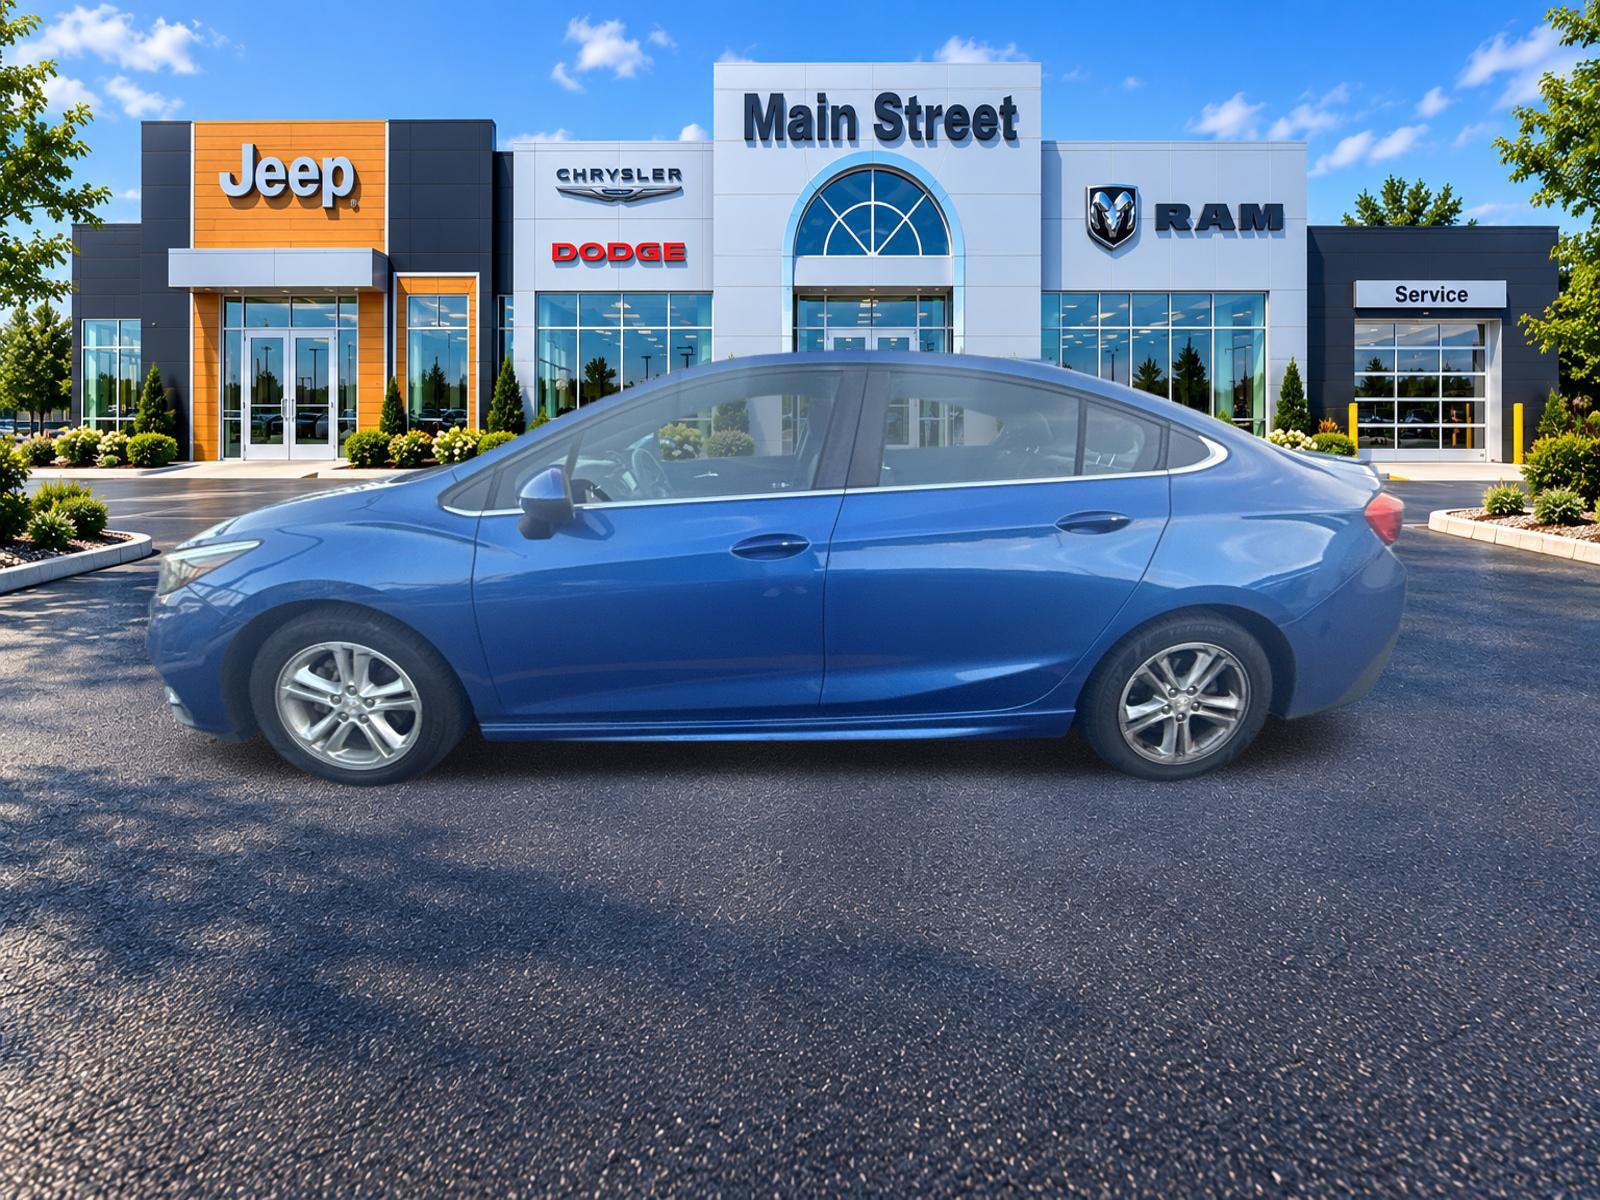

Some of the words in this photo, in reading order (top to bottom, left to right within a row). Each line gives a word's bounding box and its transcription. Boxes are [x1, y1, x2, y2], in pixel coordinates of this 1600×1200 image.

[744, 93, 857, 141] Main
[873, 92, 1017, 141] Street
[218, 143, 355, 208] Jeep
[556, 168, 683, 182] CHRYSLER
[1155, 203, 1284, 231] RAM
[551, 242, 687, 262] DODGE
[1394, 285, 1469, 303] Service
